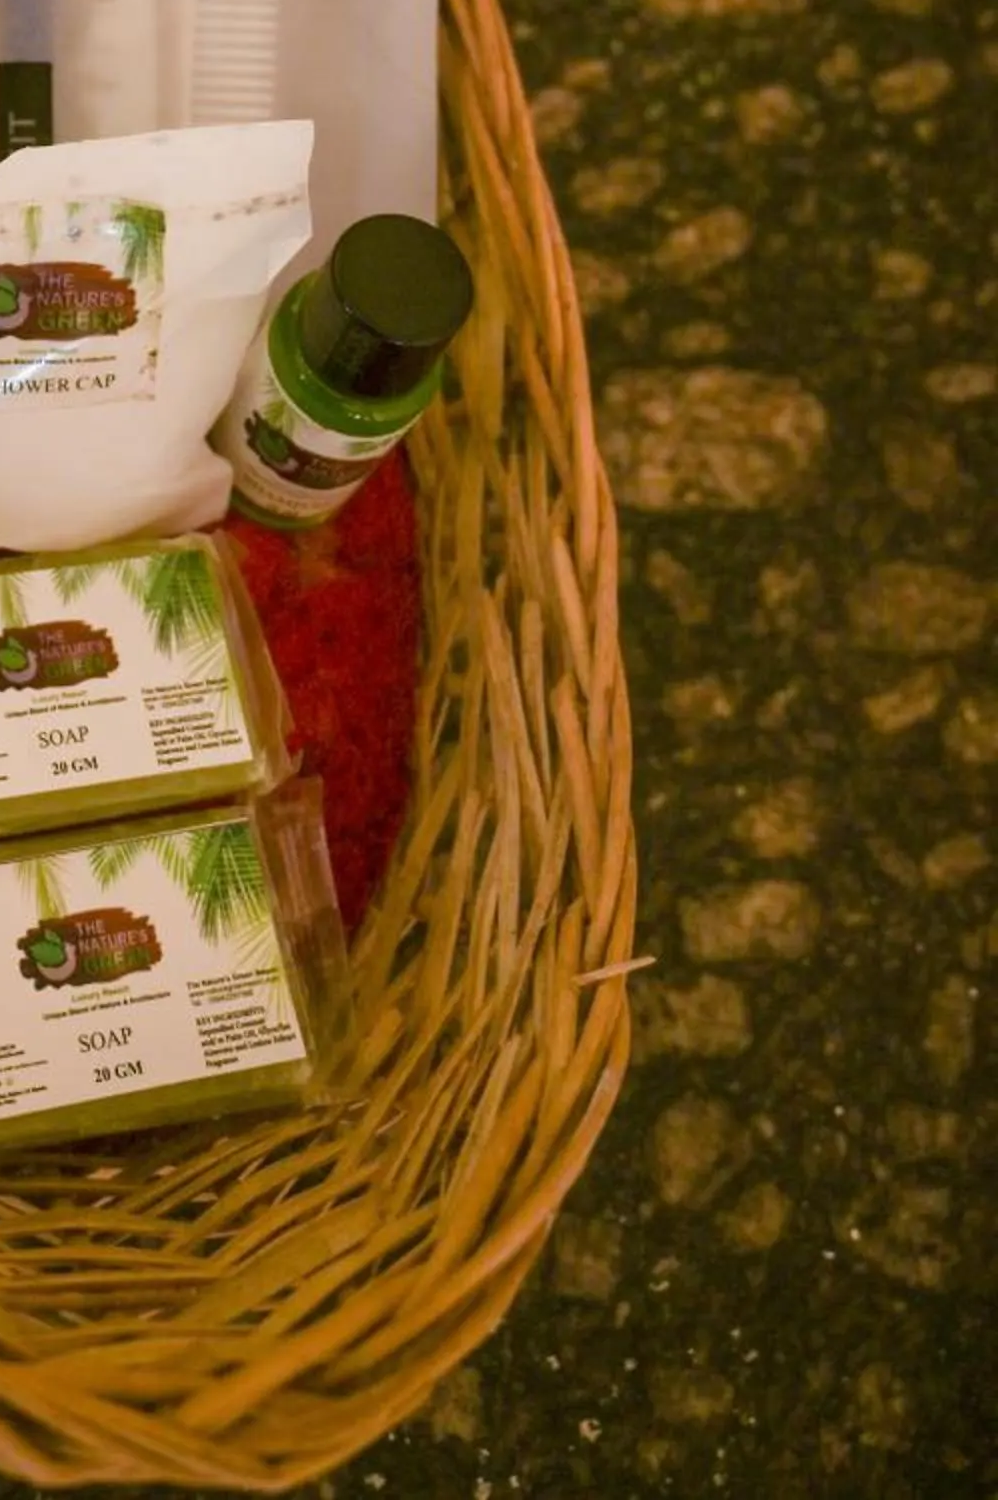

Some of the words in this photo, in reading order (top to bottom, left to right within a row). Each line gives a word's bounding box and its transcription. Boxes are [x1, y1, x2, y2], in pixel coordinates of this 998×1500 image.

[37, 272, 75, 288] THE
[37, 308, 126, 332] GREEN
[75, 373, 116, 391] CAP
[37, 725, 90, 749] SOAP
[51, 761, 69, 776] 20
[70, 755, 99, 773] GM
[76, 919, 105, 937] THE
[77, 1026, 133, 1053] SOAP
[93, 1066, 111, 1083] 20
[114, 1060, 143, 1079] GM
